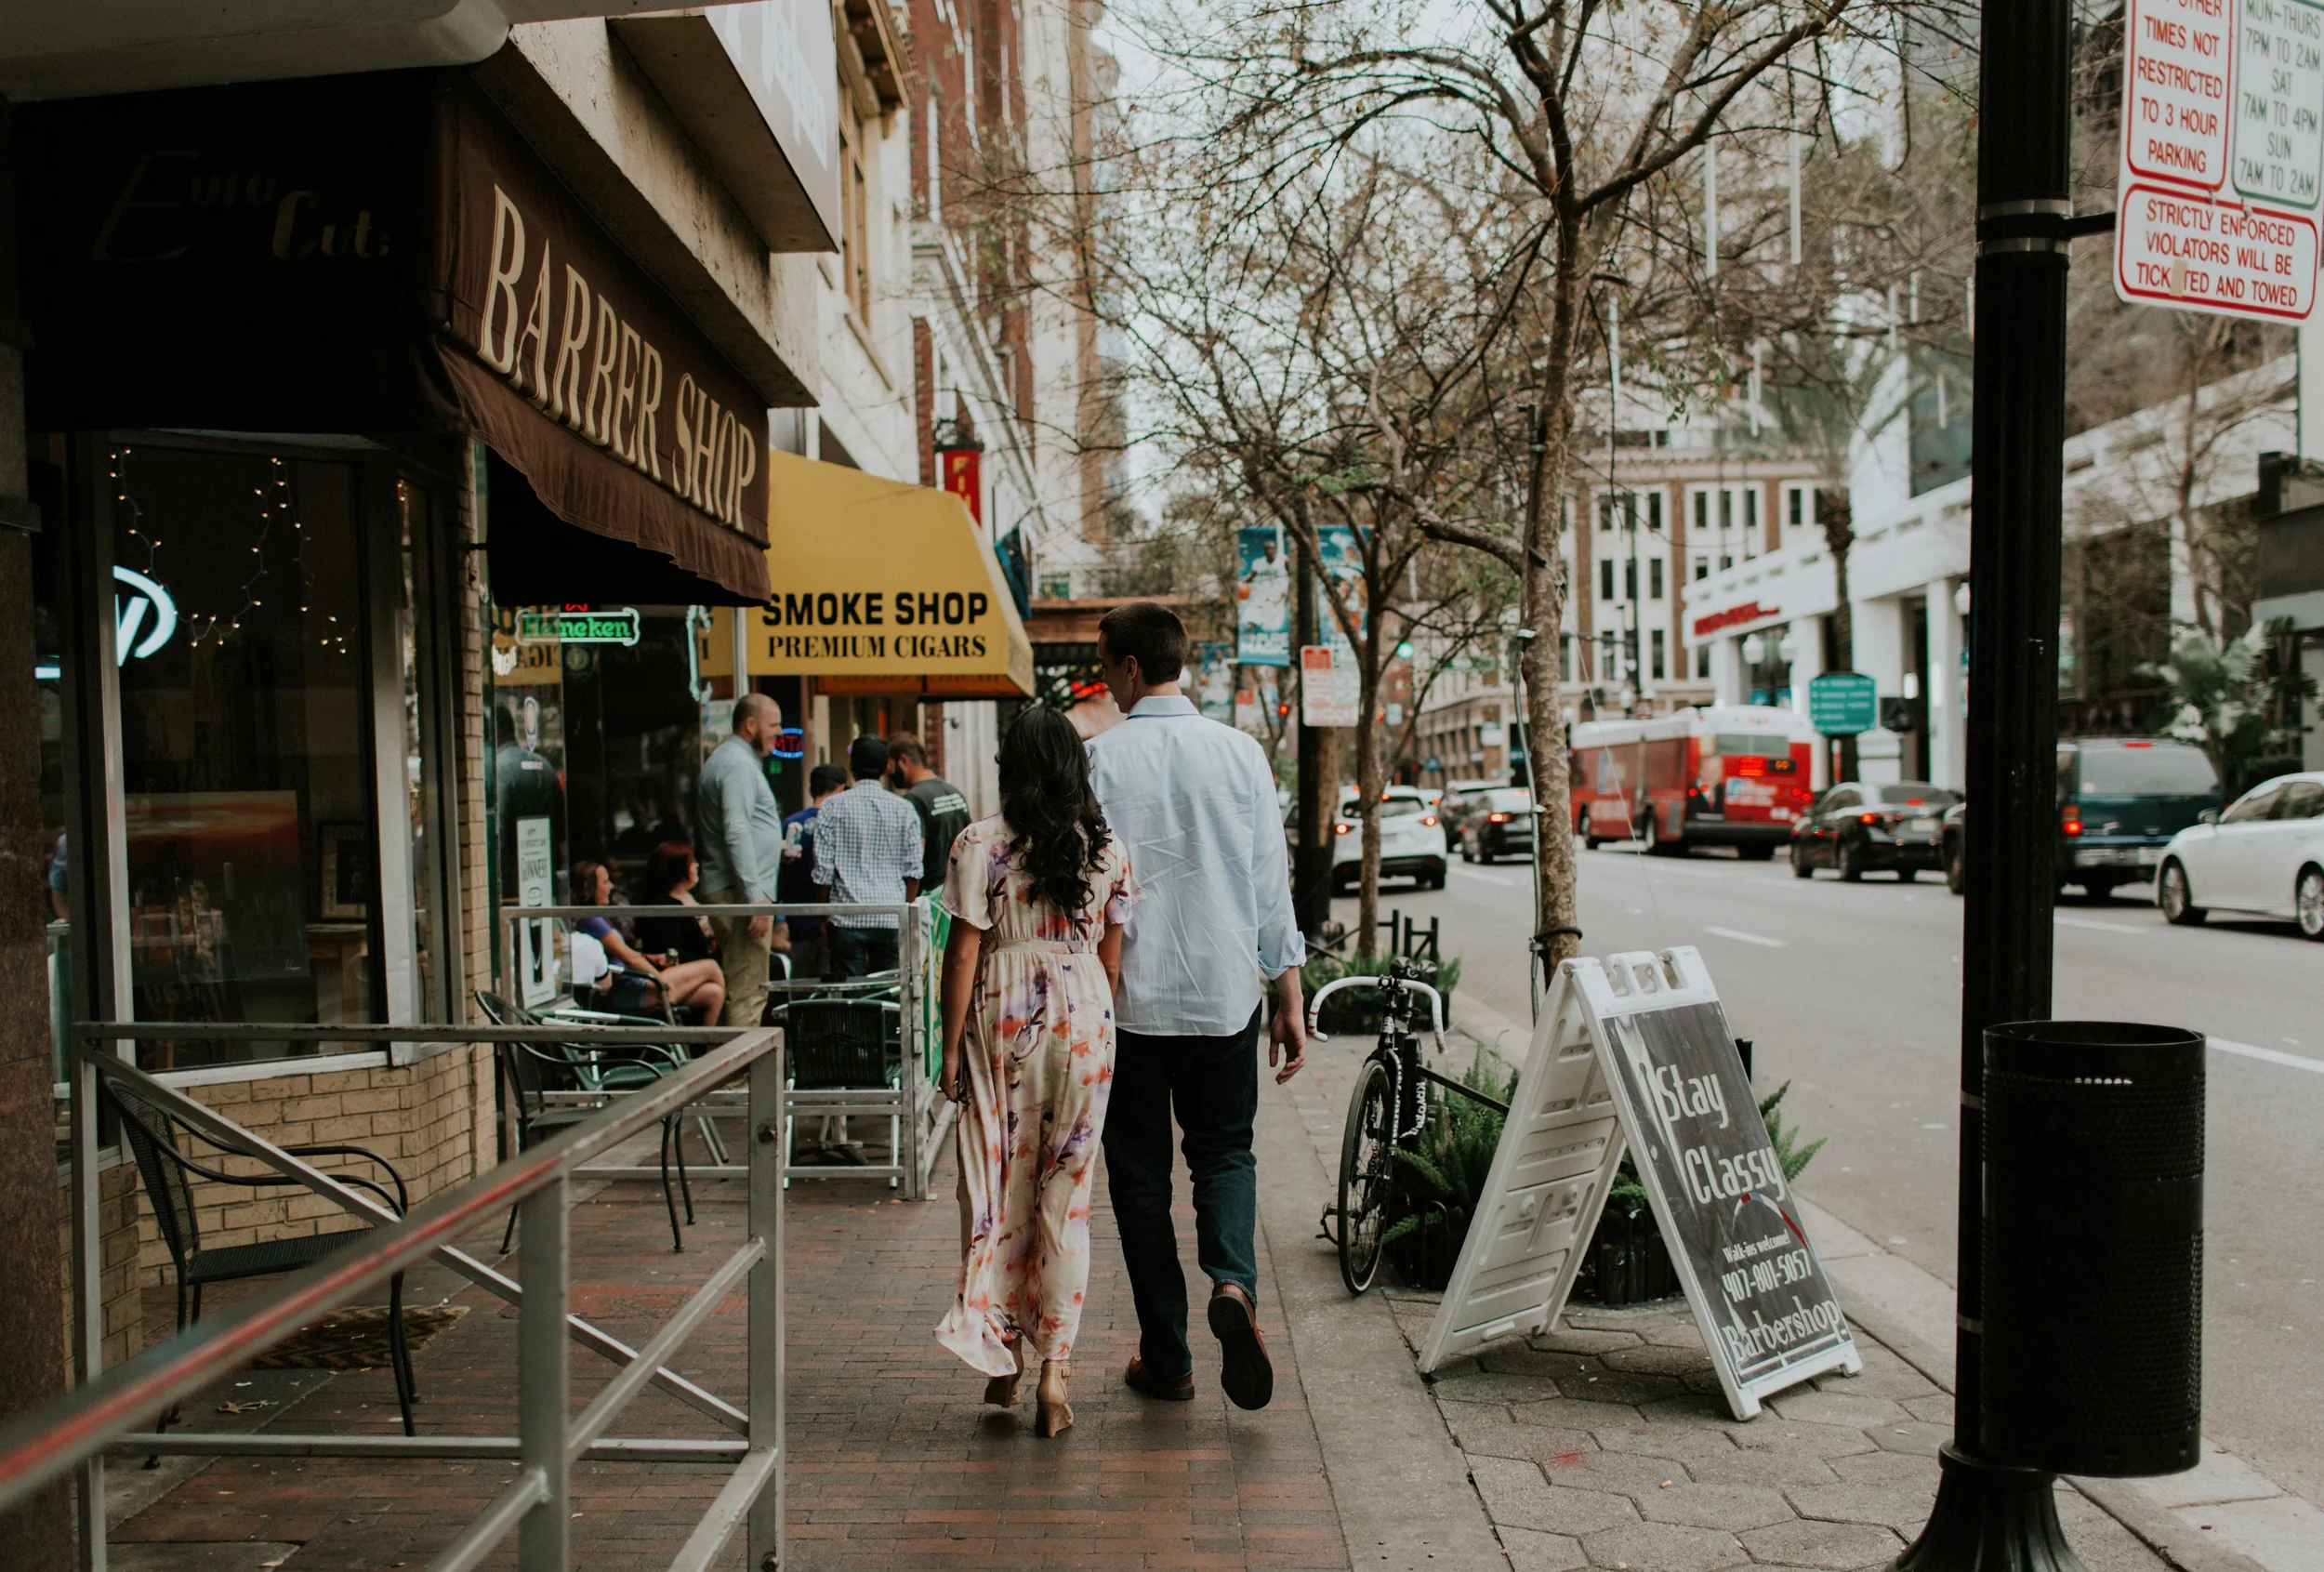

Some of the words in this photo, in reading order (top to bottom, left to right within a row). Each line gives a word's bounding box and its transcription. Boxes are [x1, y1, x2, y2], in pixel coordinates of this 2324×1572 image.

[2144, 15, 2186, 49] TIMES
[2193, 29, 2220, 57] NOT
[2245, 28, 2270, 58] 7PM
[2276, 36, 2290, 63] TO
[2296, 44, 2320, 73] 2AM
[2138, 56, 2223, 99] RESTRICTED
[2271, 69, 2292, 97] SAT
[2141, 97, 2159, 123] TO
[2165, 104, 2173, 126] 3
[2181, 107, 2217, 138] HOUR
[2243, 93, 2267, 122] 7AM
[2274, 101, 2287, 128] TO
[2292, 108, 2317, 135] 4PM
[2147, 139, 2206, 174] PARKING
[2267, 132, 2291, 161] SUN
[2239, 158, 2264, 185] 7AM
[2270, 165, 2284, 193] TO
[2291, 172, 2315, 198] 2AM
[2146, 199, 2214, 231] STRICTLY
[2221, 214, 2295, 247] ENFORCED
[2146, 231, 2229, 265] VIOLATORS
[2237, 245, 2268, 272] WILL
[2275, 253, 2292, 276] BE
[2136, 262, 2209, 294] TICKTED
[2216, 275, 2245, 299] AND
[2251, 281, 2297, 307] TOWED
[477, 183, 664, 482] BARBER
[673, 373, 756, 533] SHOP
[762, 592, 883, 626] SMOKE
[895, 592, 987, 625] SHOP
[768, 636, 885, 658] PREMIUM
[894, 635, 986, 658] CIGARS
[1656, 1063, 1729, 1128] Stay
[1684, 1146, 1786, 1205] Classy
[1723, 1241, 1757, 1262] Walk-ins
[1756, 1229, 1790, 1254] welcome!
[1722, 1248, 1812, 1302] 407-801-5057
[1722, 1295, 1845, 1362] Barbershop
